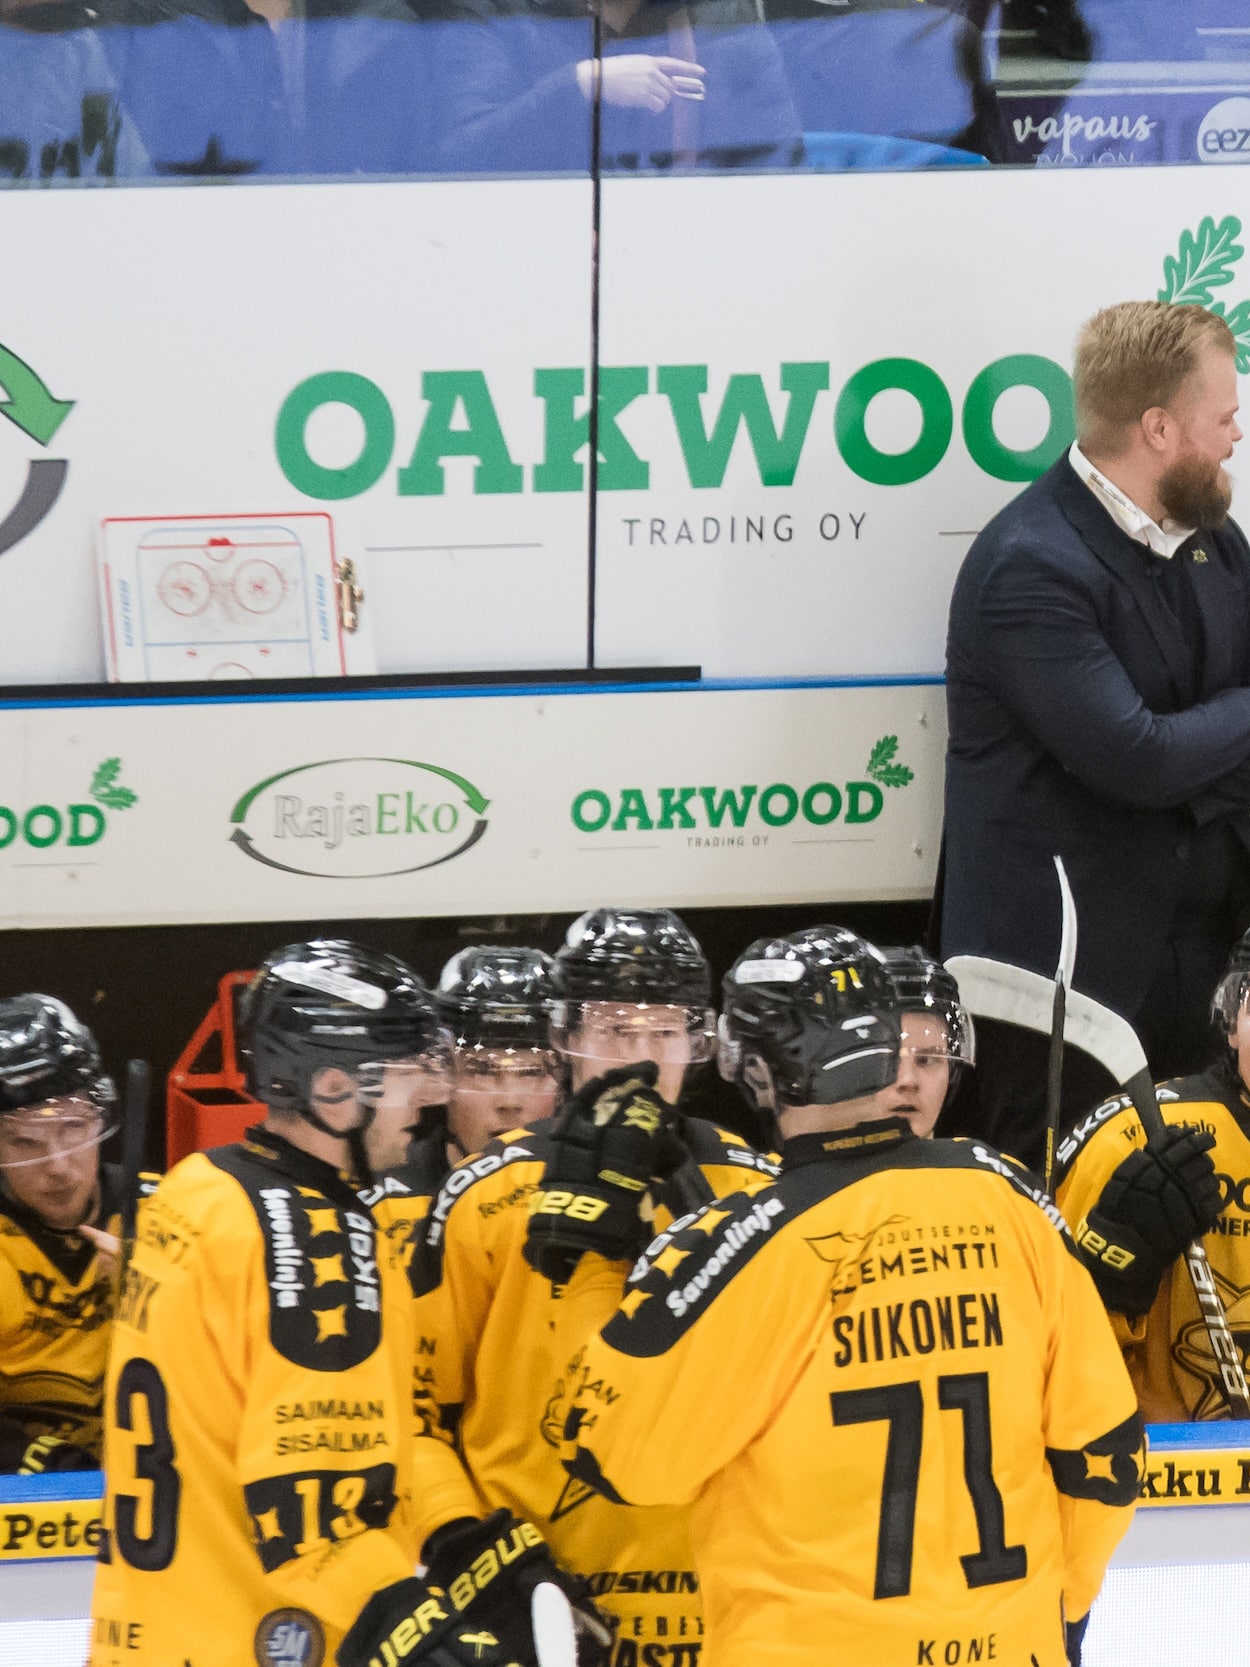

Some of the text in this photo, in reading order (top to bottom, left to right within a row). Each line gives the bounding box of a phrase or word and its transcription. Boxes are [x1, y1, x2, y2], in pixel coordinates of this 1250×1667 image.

[1012, 112, 1158, 155] vapaus
[274, 354, 1077, 501] OAKWOO
[622, 512, 867, 546] TRADING OY
[273, 791, 459, 850] RajaEko
[571, 781, 884, 832] OAKWOOD
[687, 835, 769, 848] TRADING OY
[666, 1197, 785, 1318] Savonlinja
[831, 1243, 999, 1300] EMENTTI
[833, 1293, 1003, 1368] SIIKONEN
[274, 1399, 385, 1425] SAIMAAN
[97, 1357, 182, 1571] 3
[829, 1371, 1028, 1600] 71
[3, 1512, 101, 1550] Pete
[917, 1633, 998, 1667] KONE
